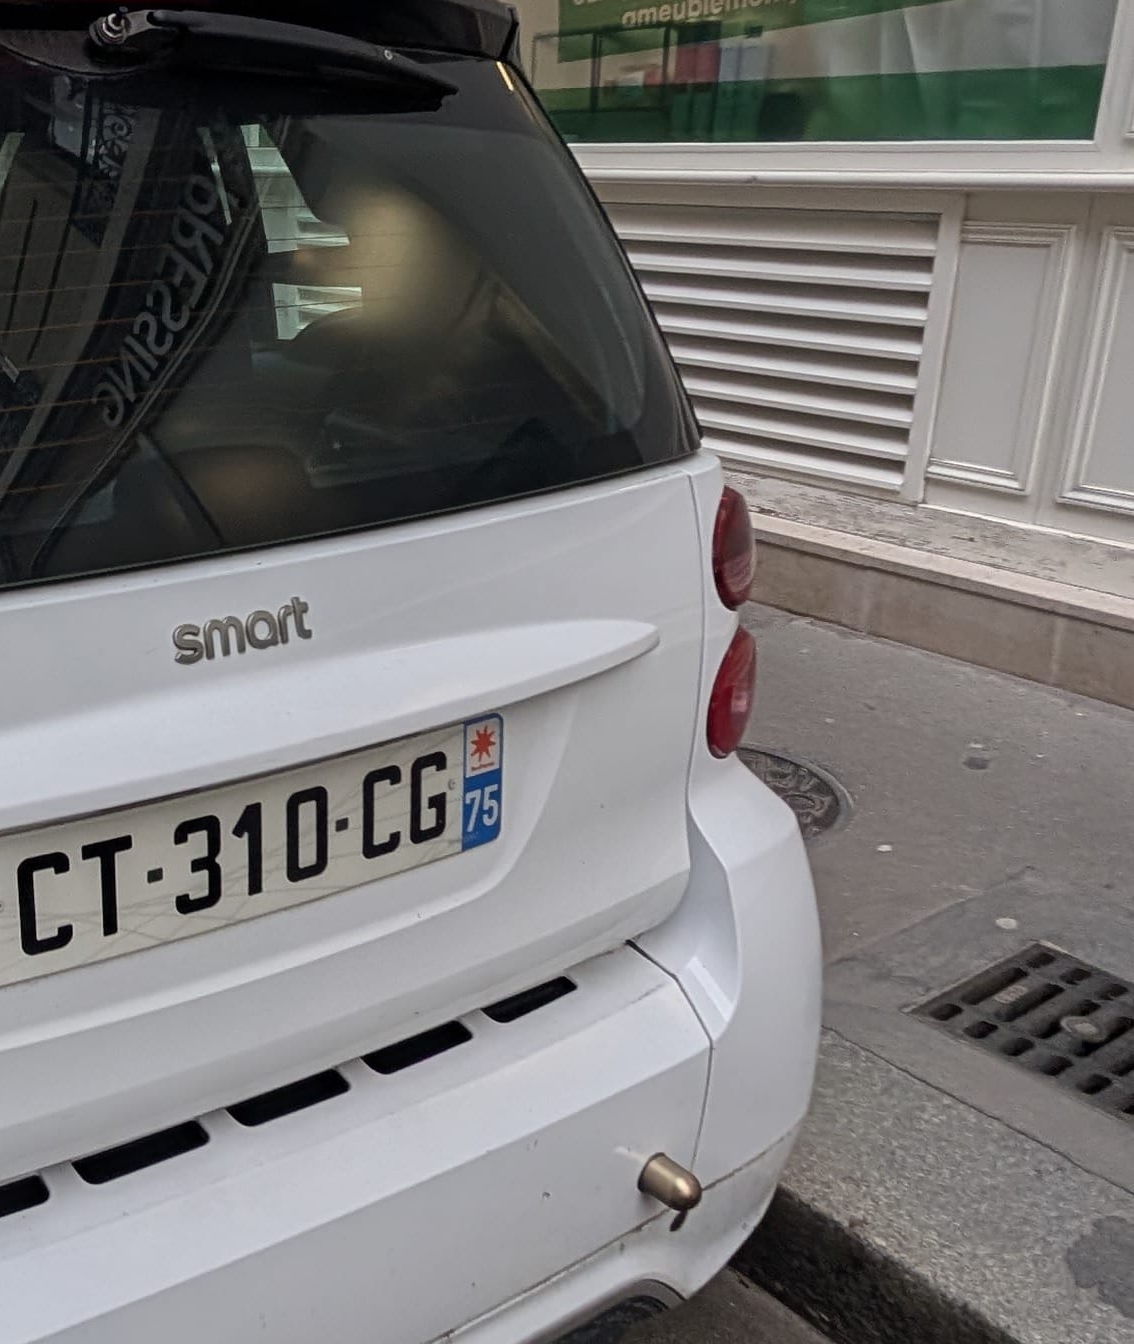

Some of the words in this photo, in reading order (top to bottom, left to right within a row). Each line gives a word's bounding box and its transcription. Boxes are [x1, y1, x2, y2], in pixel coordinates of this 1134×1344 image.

[172, 596, 313, 665] smart
[465, 784, 499, 833] 75
[16, 750, 449, 956] CT-310-CG
